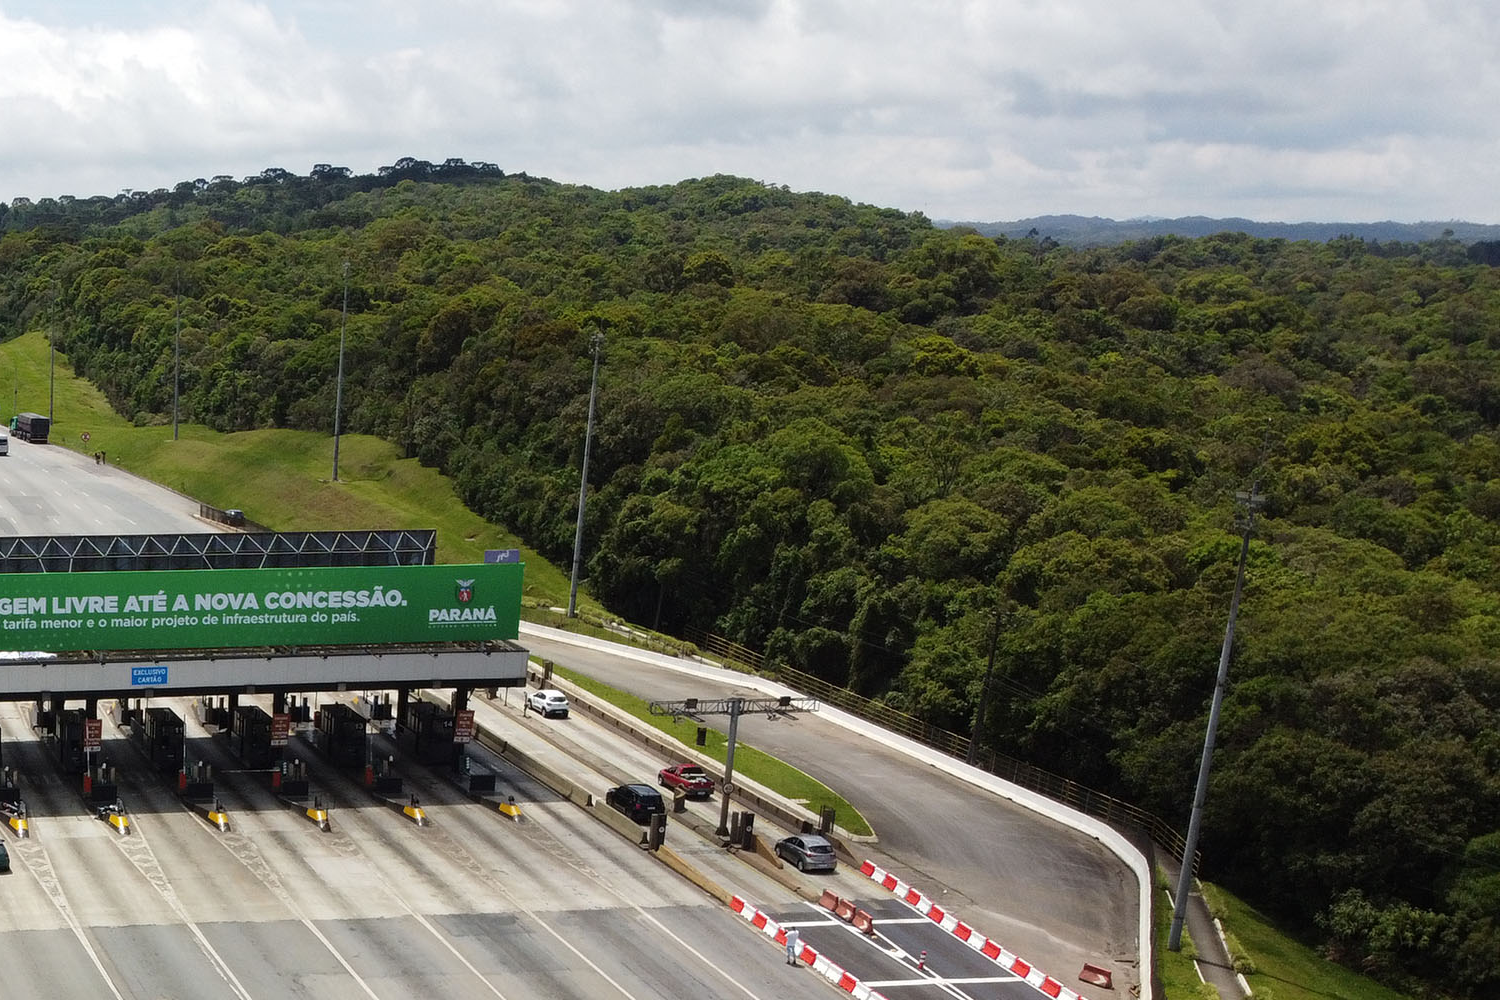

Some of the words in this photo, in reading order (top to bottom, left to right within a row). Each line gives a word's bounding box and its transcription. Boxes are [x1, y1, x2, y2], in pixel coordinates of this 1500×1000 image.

[52, 596, 118, 614] LIVRE
[123, 590, 167, 613] ATÉ
[172, 594, 190, 611] A
[194, 592, 259, 611] NOVA
[264, 585, 408, 610] CONCESSÃO.
[3, 618, 37, 630] tarifa
[40, 619, 83, 629] menor
[86, 619, 95, 628] e
[98, 618, 108, 628] o
[111, 616, 149, 627] maior
[151, 615, 199, 629] projeto
[202, 613, 219, 625] de
[222, 612, 308, 625] infraestrutura
[310, 611, 328, 623] do
[331, 611, 360, 624] país.
[428, 605, 498, 622] PARANÁ
[133, 668, 166, 676] EXCLUSIVO
[443, 720, 453, 728] 14
